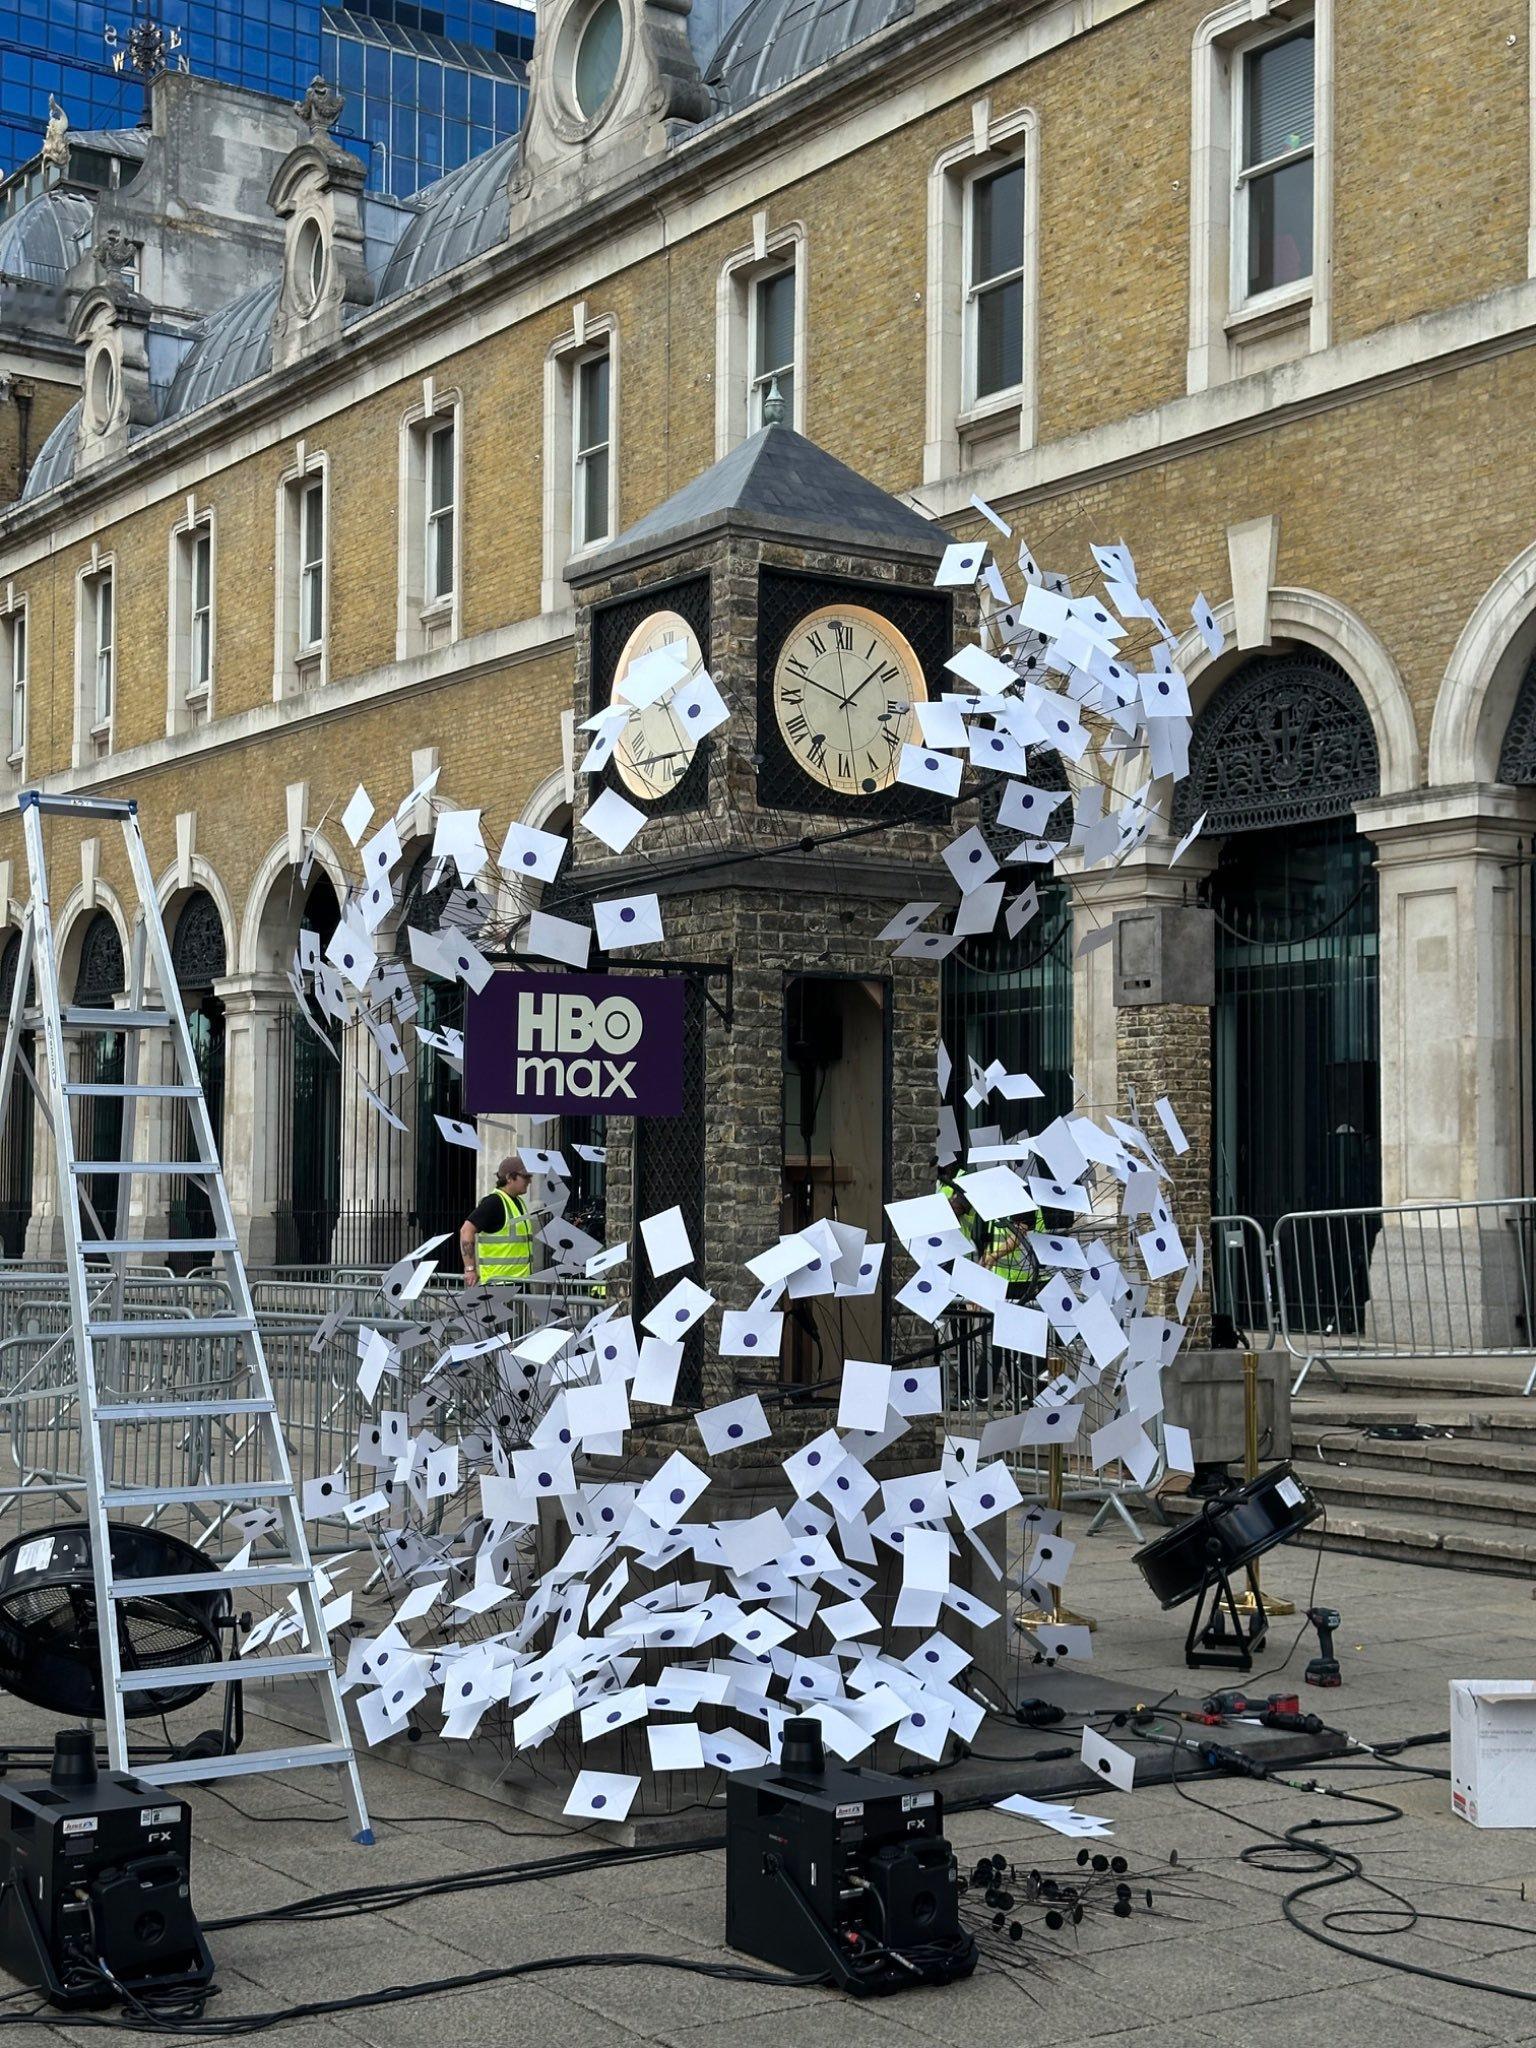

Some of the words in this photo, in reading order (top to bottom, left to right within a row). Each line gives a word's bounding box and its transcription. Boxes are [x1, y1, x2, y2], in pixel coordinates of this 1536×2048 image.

[806, 630, 827, 657] XI
[866, 640, 877, 660] I
[788, 654, 809, 675] X
[880, 666, 899, 683] II
[785, 714, 810, 746] VIII
[838, 753, 850, 778] VI
[866, 750, 879, 773] V
[517, 992, 643, 1055] HBO
[516, 1057, 637, 1098] max
[907, 1819, 925, 1830] FX
[148, 1831, 171, 1842] FX
